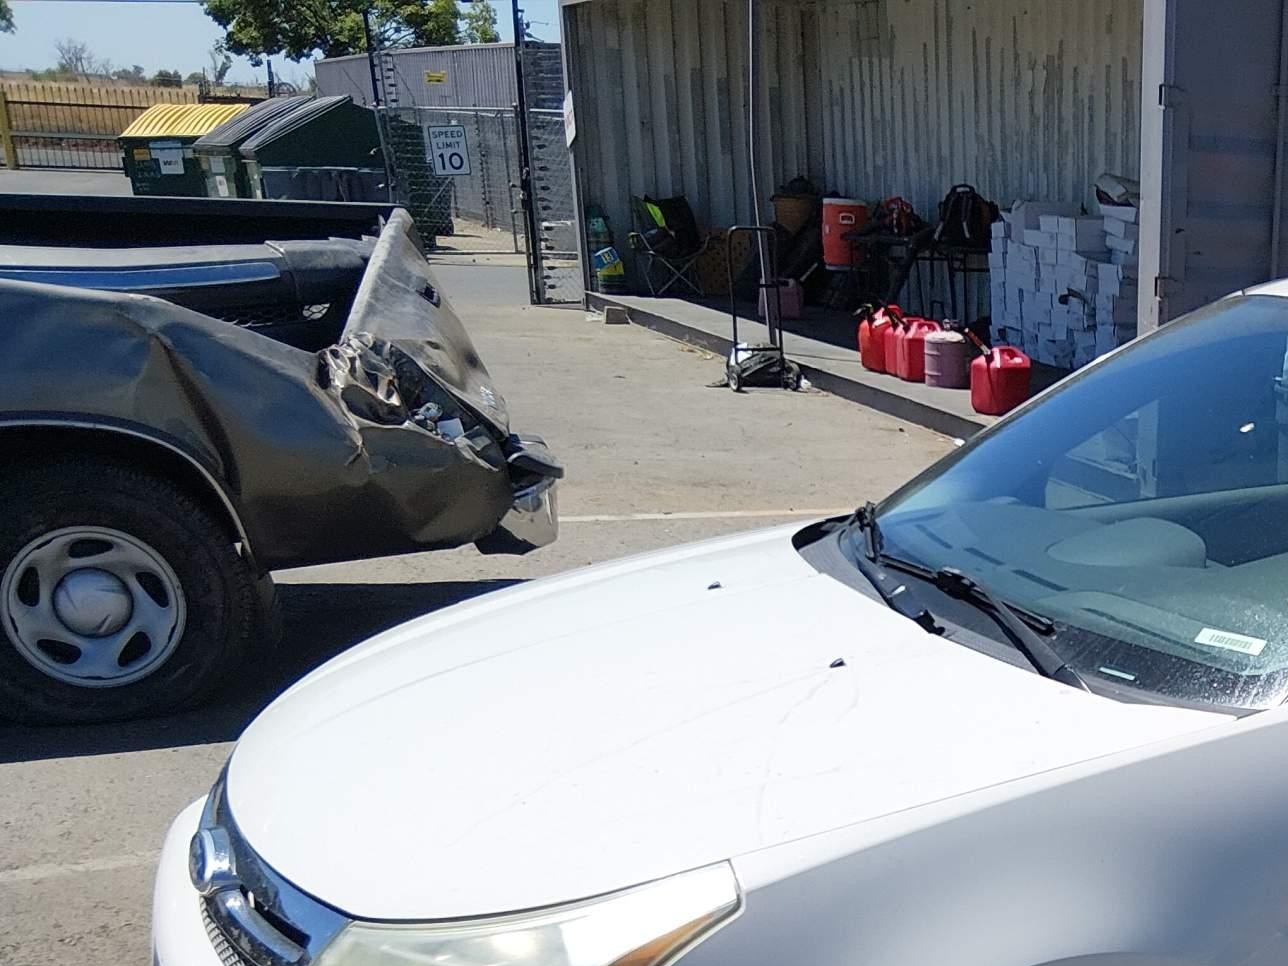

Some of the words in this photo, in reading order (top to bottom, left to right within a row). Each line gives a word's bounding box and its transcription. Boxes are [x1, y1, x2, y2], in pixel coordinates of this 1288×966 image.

[431, 130, 463, 139] SPEED
[436, 141, 460, 149] LIMIT
[438, 152, 464, 170] 10
